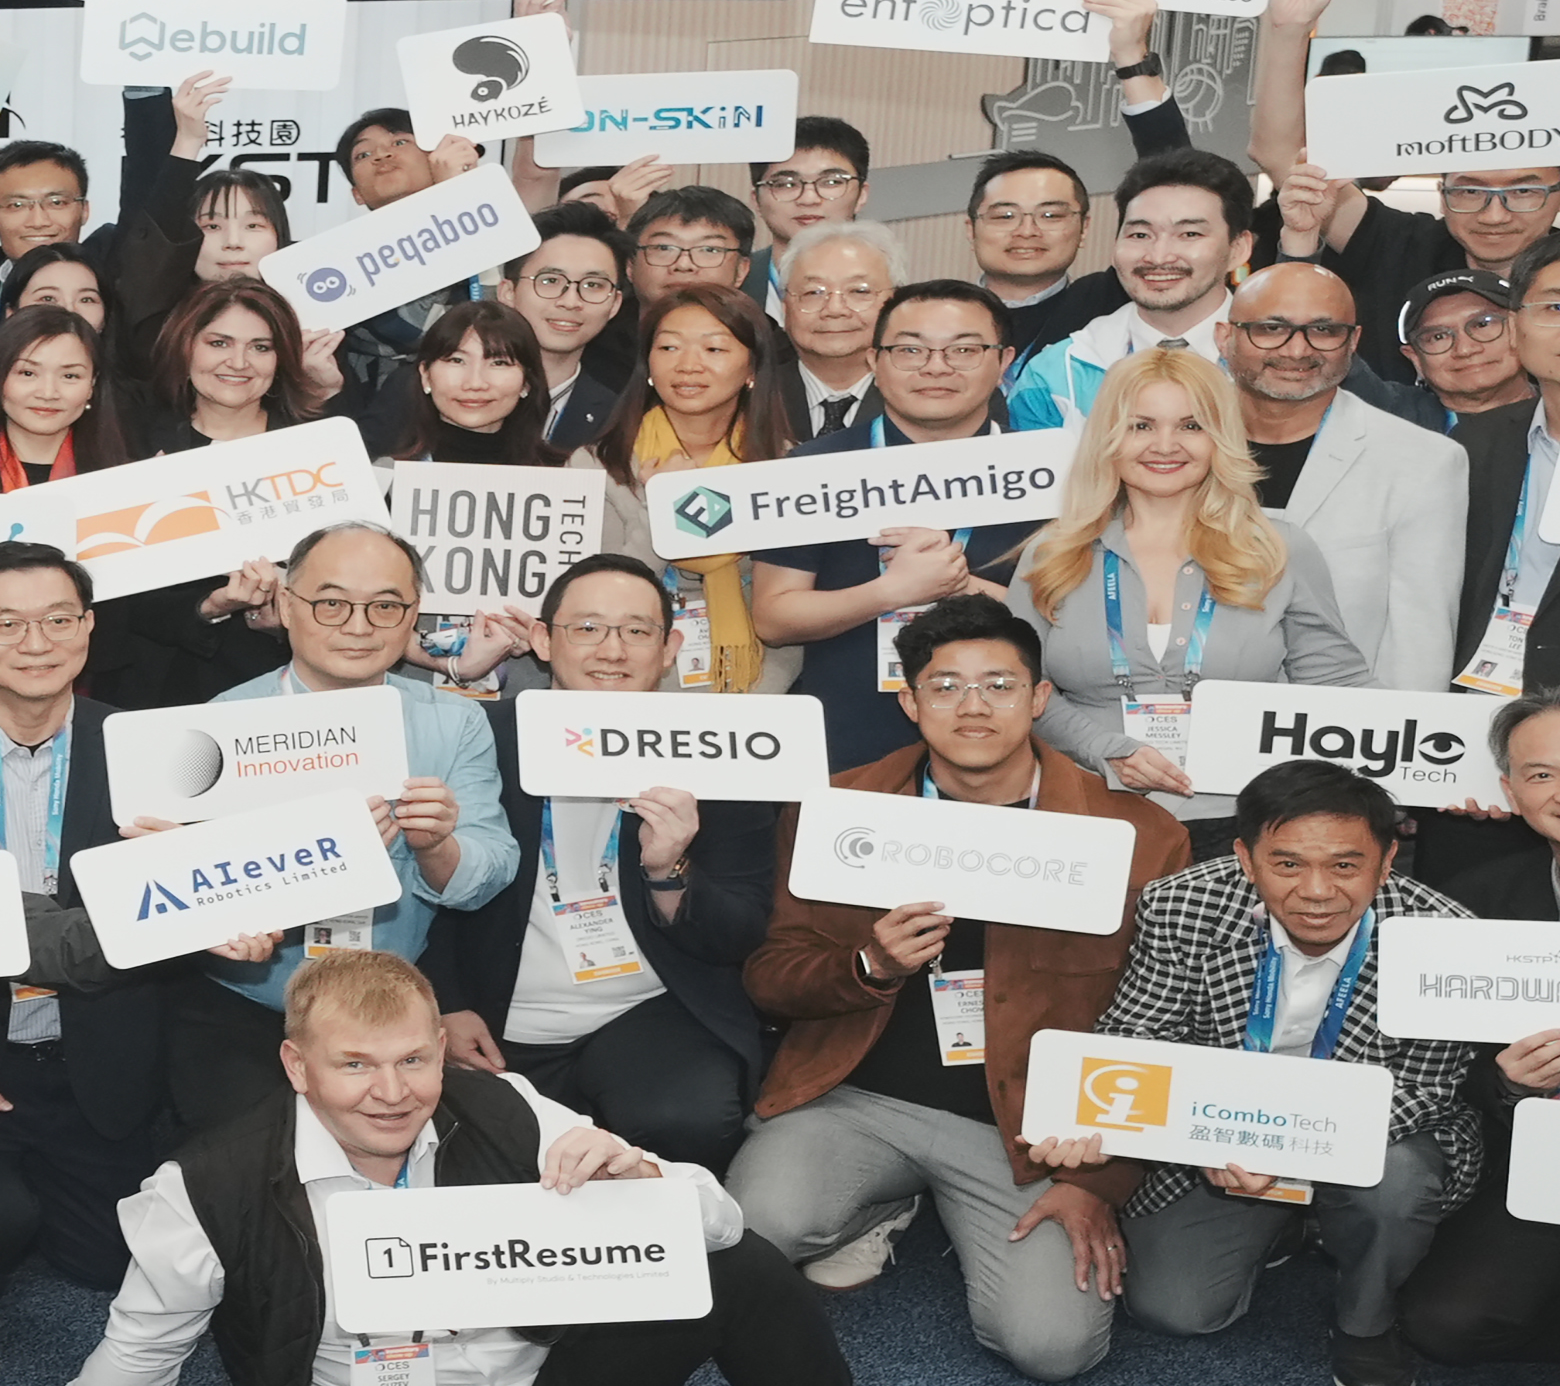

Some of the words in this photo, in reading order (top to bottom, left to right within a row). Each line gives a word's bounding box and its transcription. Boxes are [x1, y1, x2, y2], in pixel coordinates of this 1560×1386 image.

[451, 96, 553, 129] HAYKOZÉ
[355, 202, 500, 287] peqaboo
[1427, 276, 1457, 292] RUN
[225, 461, 344, 510] HKTDC
[749, 464, 1056, 521] FreightAmigo
[235, 487, 350, 526] 香港貿發局
[409, 487, 552, 542] HONG
[557, 494, 587, 567] TECH
[234, 725, 358, 756] MERIDIAN
[600, 727, 781, 761] DRESIO
[1146, 725, 1179, 733] JESSICA
[237, 751, 359, 778] Innovation
[1400, 765, 1458, 784] Tech
[191, 836, 343, 894] AIeveR
[881, 839, 1089, 887] ROBOCORE
[195, 879, 272, 907] Robotics
[281, 861, 348, 887] Limited
[418, 1237, 666, 1274] FirstResume
[376, 1373, 410, 1383] SERGEY
